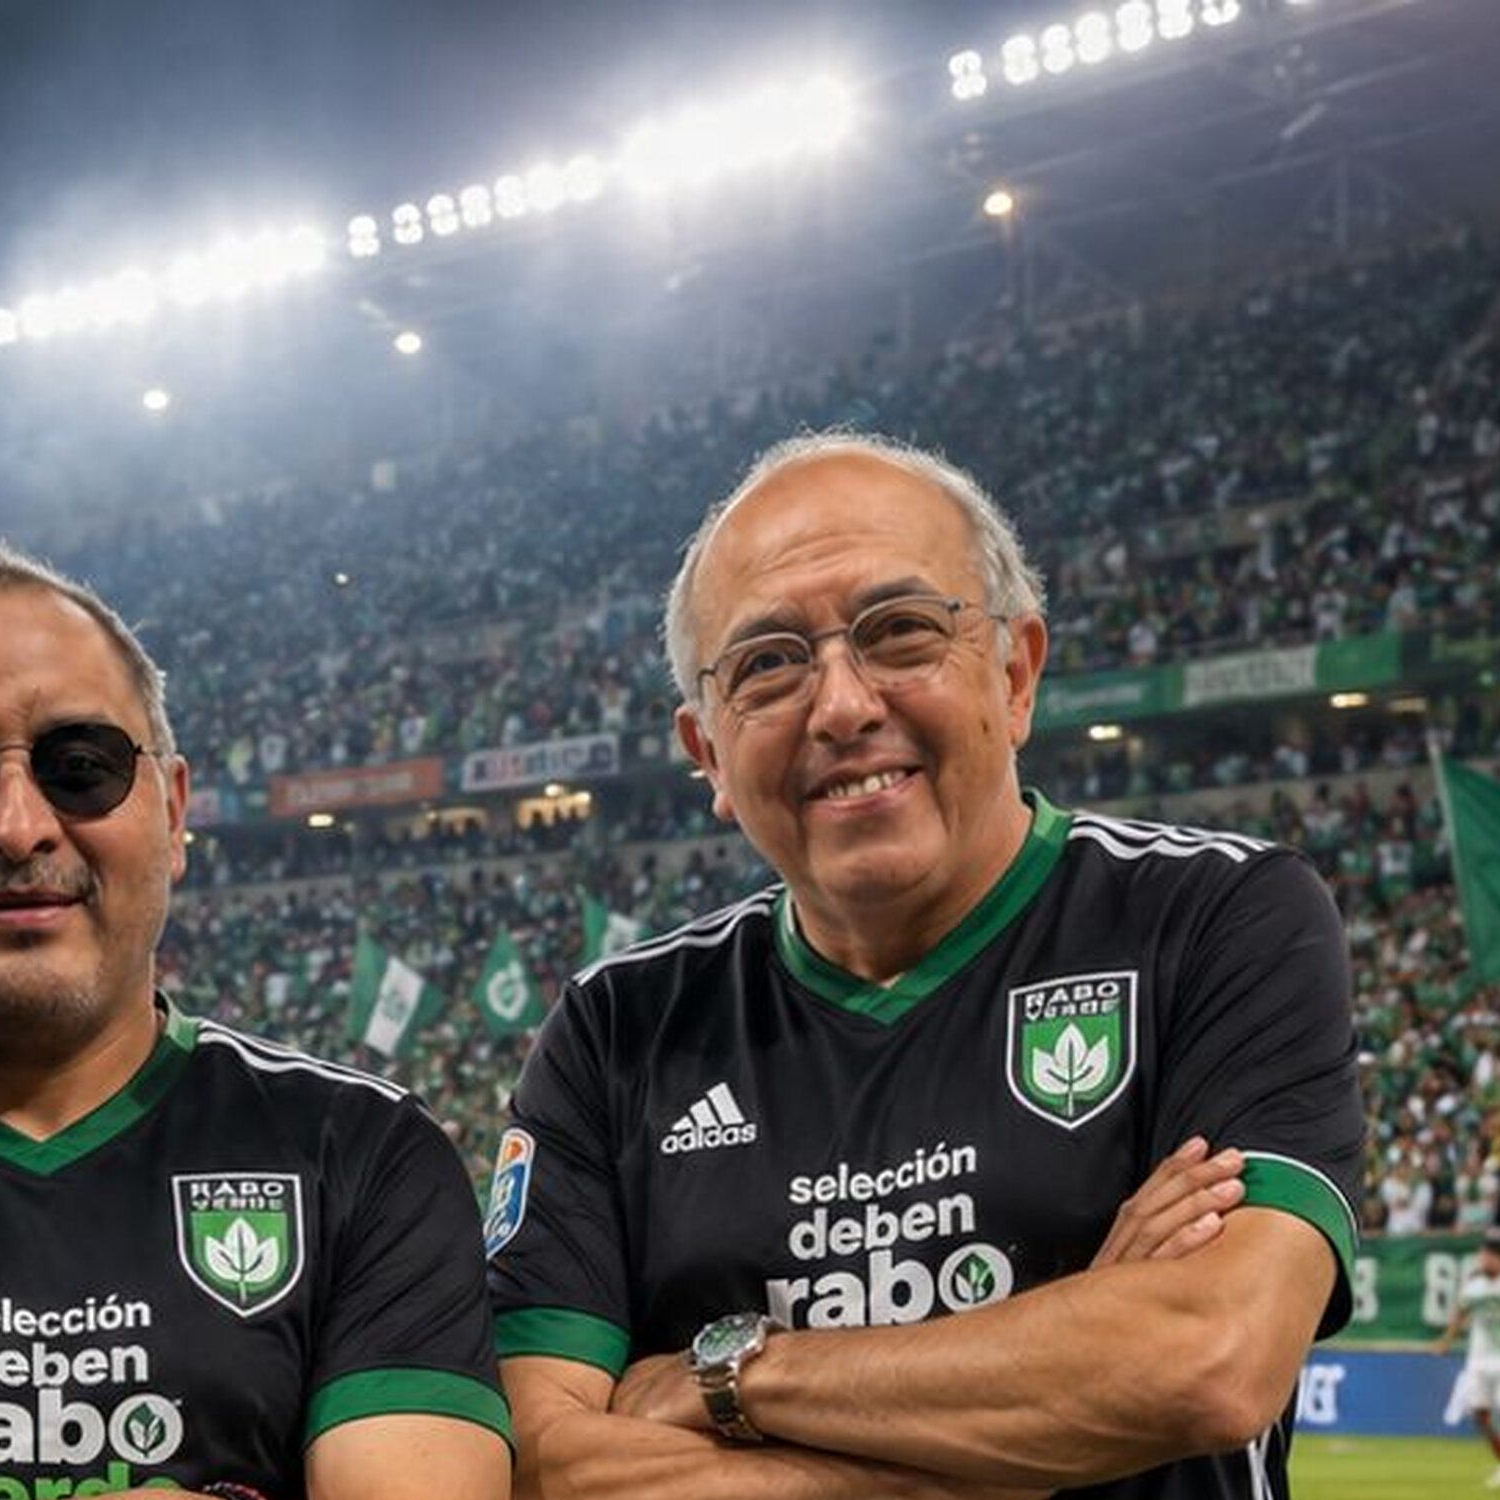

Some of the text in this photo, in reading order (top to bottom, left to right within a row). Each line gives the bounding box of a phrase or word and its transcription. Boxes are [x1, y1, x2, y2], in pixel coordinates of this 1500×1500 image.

[660, 1122, 758, 1155] adidas
[788, 1142, 976, 1204] selección
[788, 1193, 975, 1260] deben
